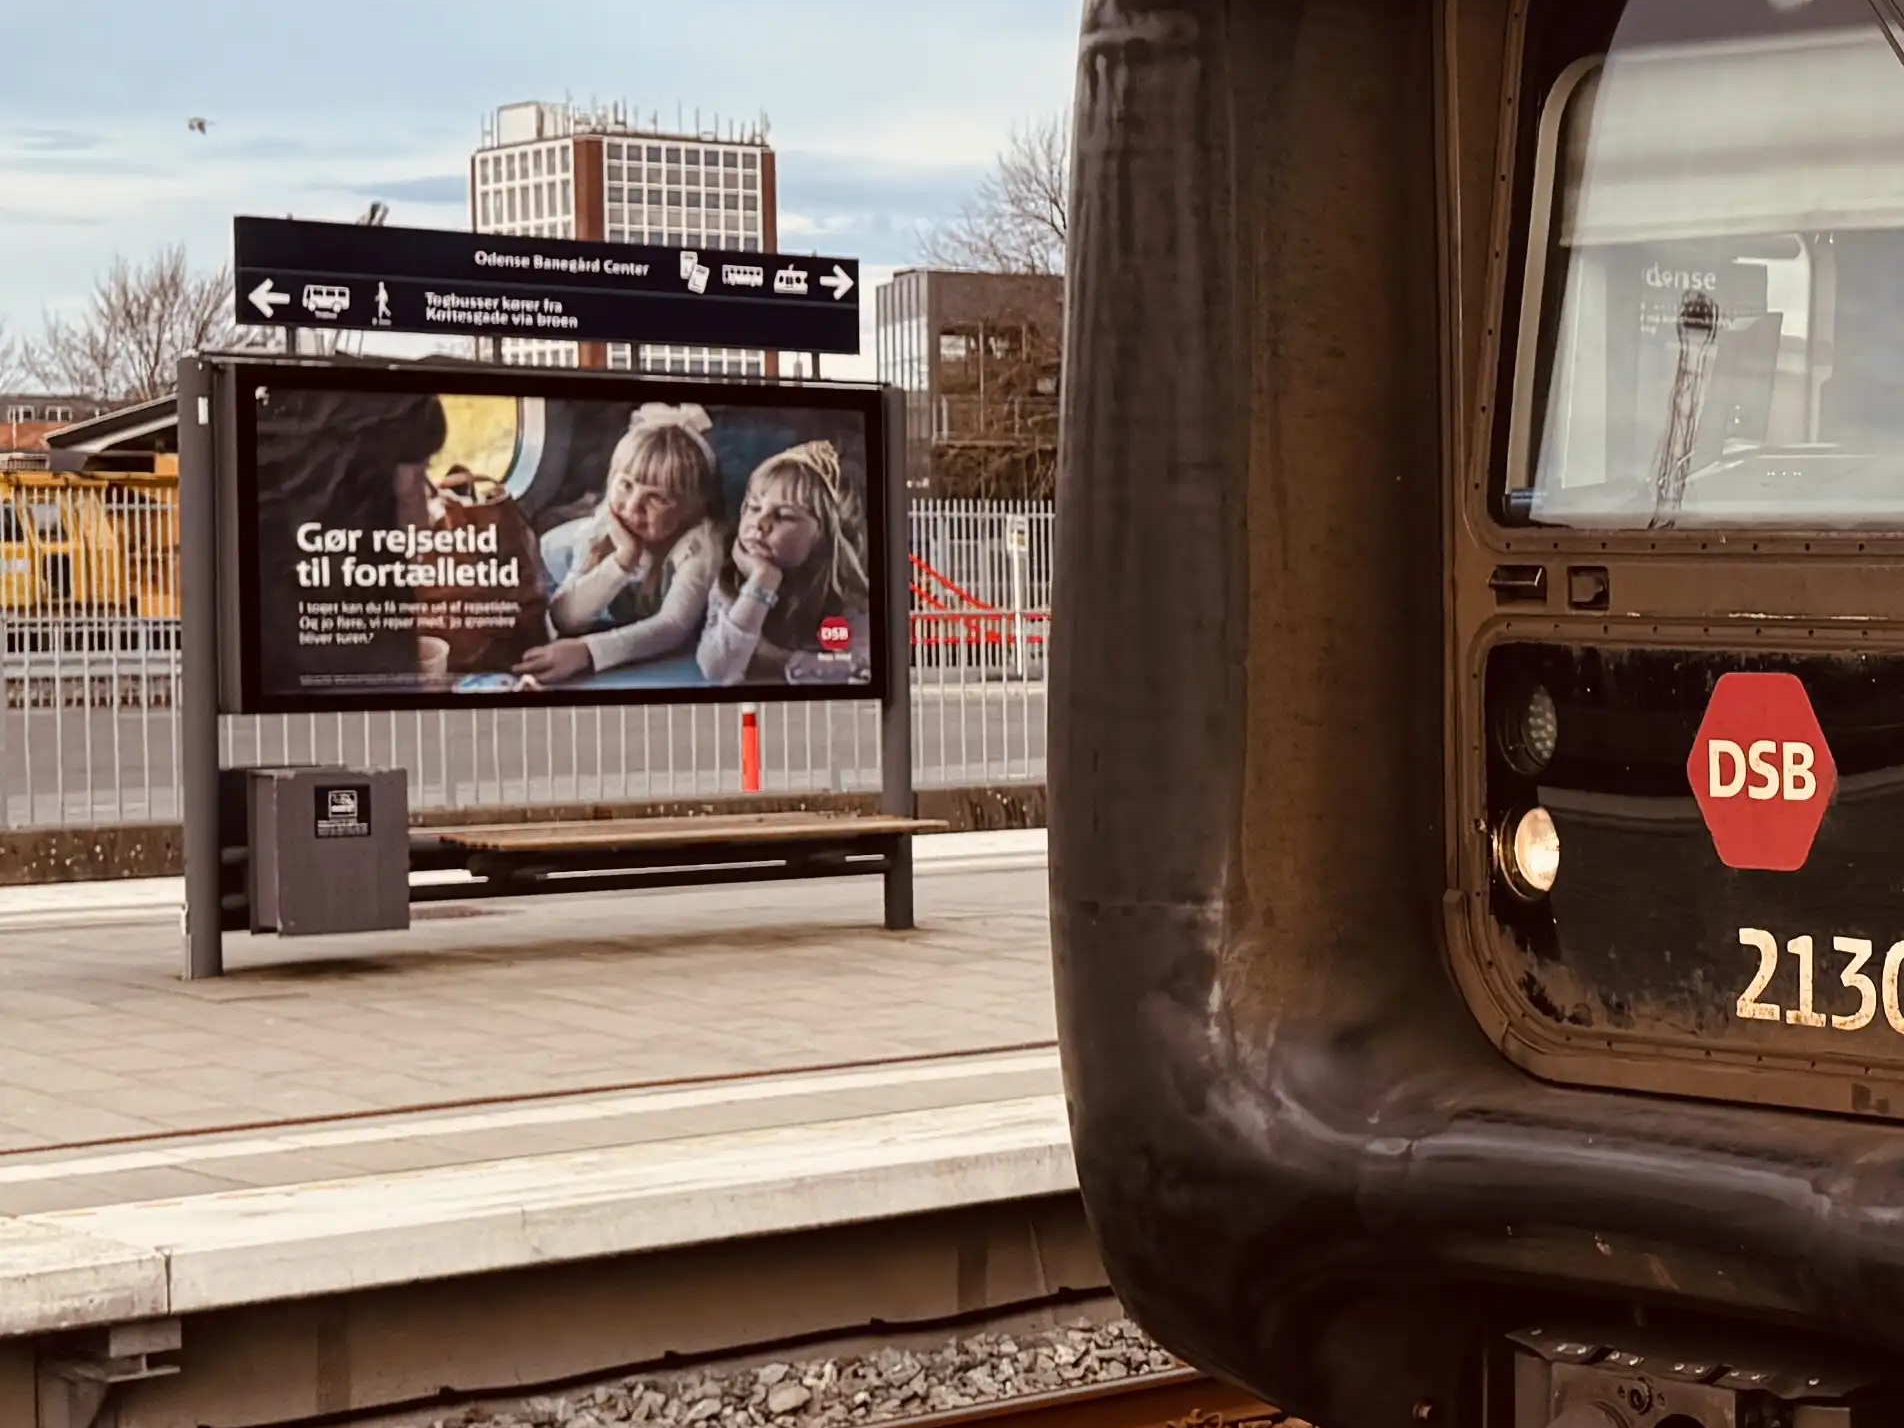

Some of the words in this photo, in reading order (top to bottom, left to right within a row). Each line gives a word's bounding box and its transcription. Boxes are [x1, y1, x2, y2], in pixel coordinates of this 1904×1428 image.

[474, 250, 530, 269] Odense
[533, 254, 600, 273] Banegård
[603, 259, 650, 276] Center
[543, 298, 563, 314] fra
[511, 311, 533, 327] via
[537, 313, 579, 329] broen
[296, 522, 363, 553] Gør
[372, 523, 498, 559] rejsetid
[296, 556, 331, 587] til
[341, 556, 520, 587] fortælletid
[821, 627, 848, 640] DSB
[1708, 739, 1817, 801] DSB
